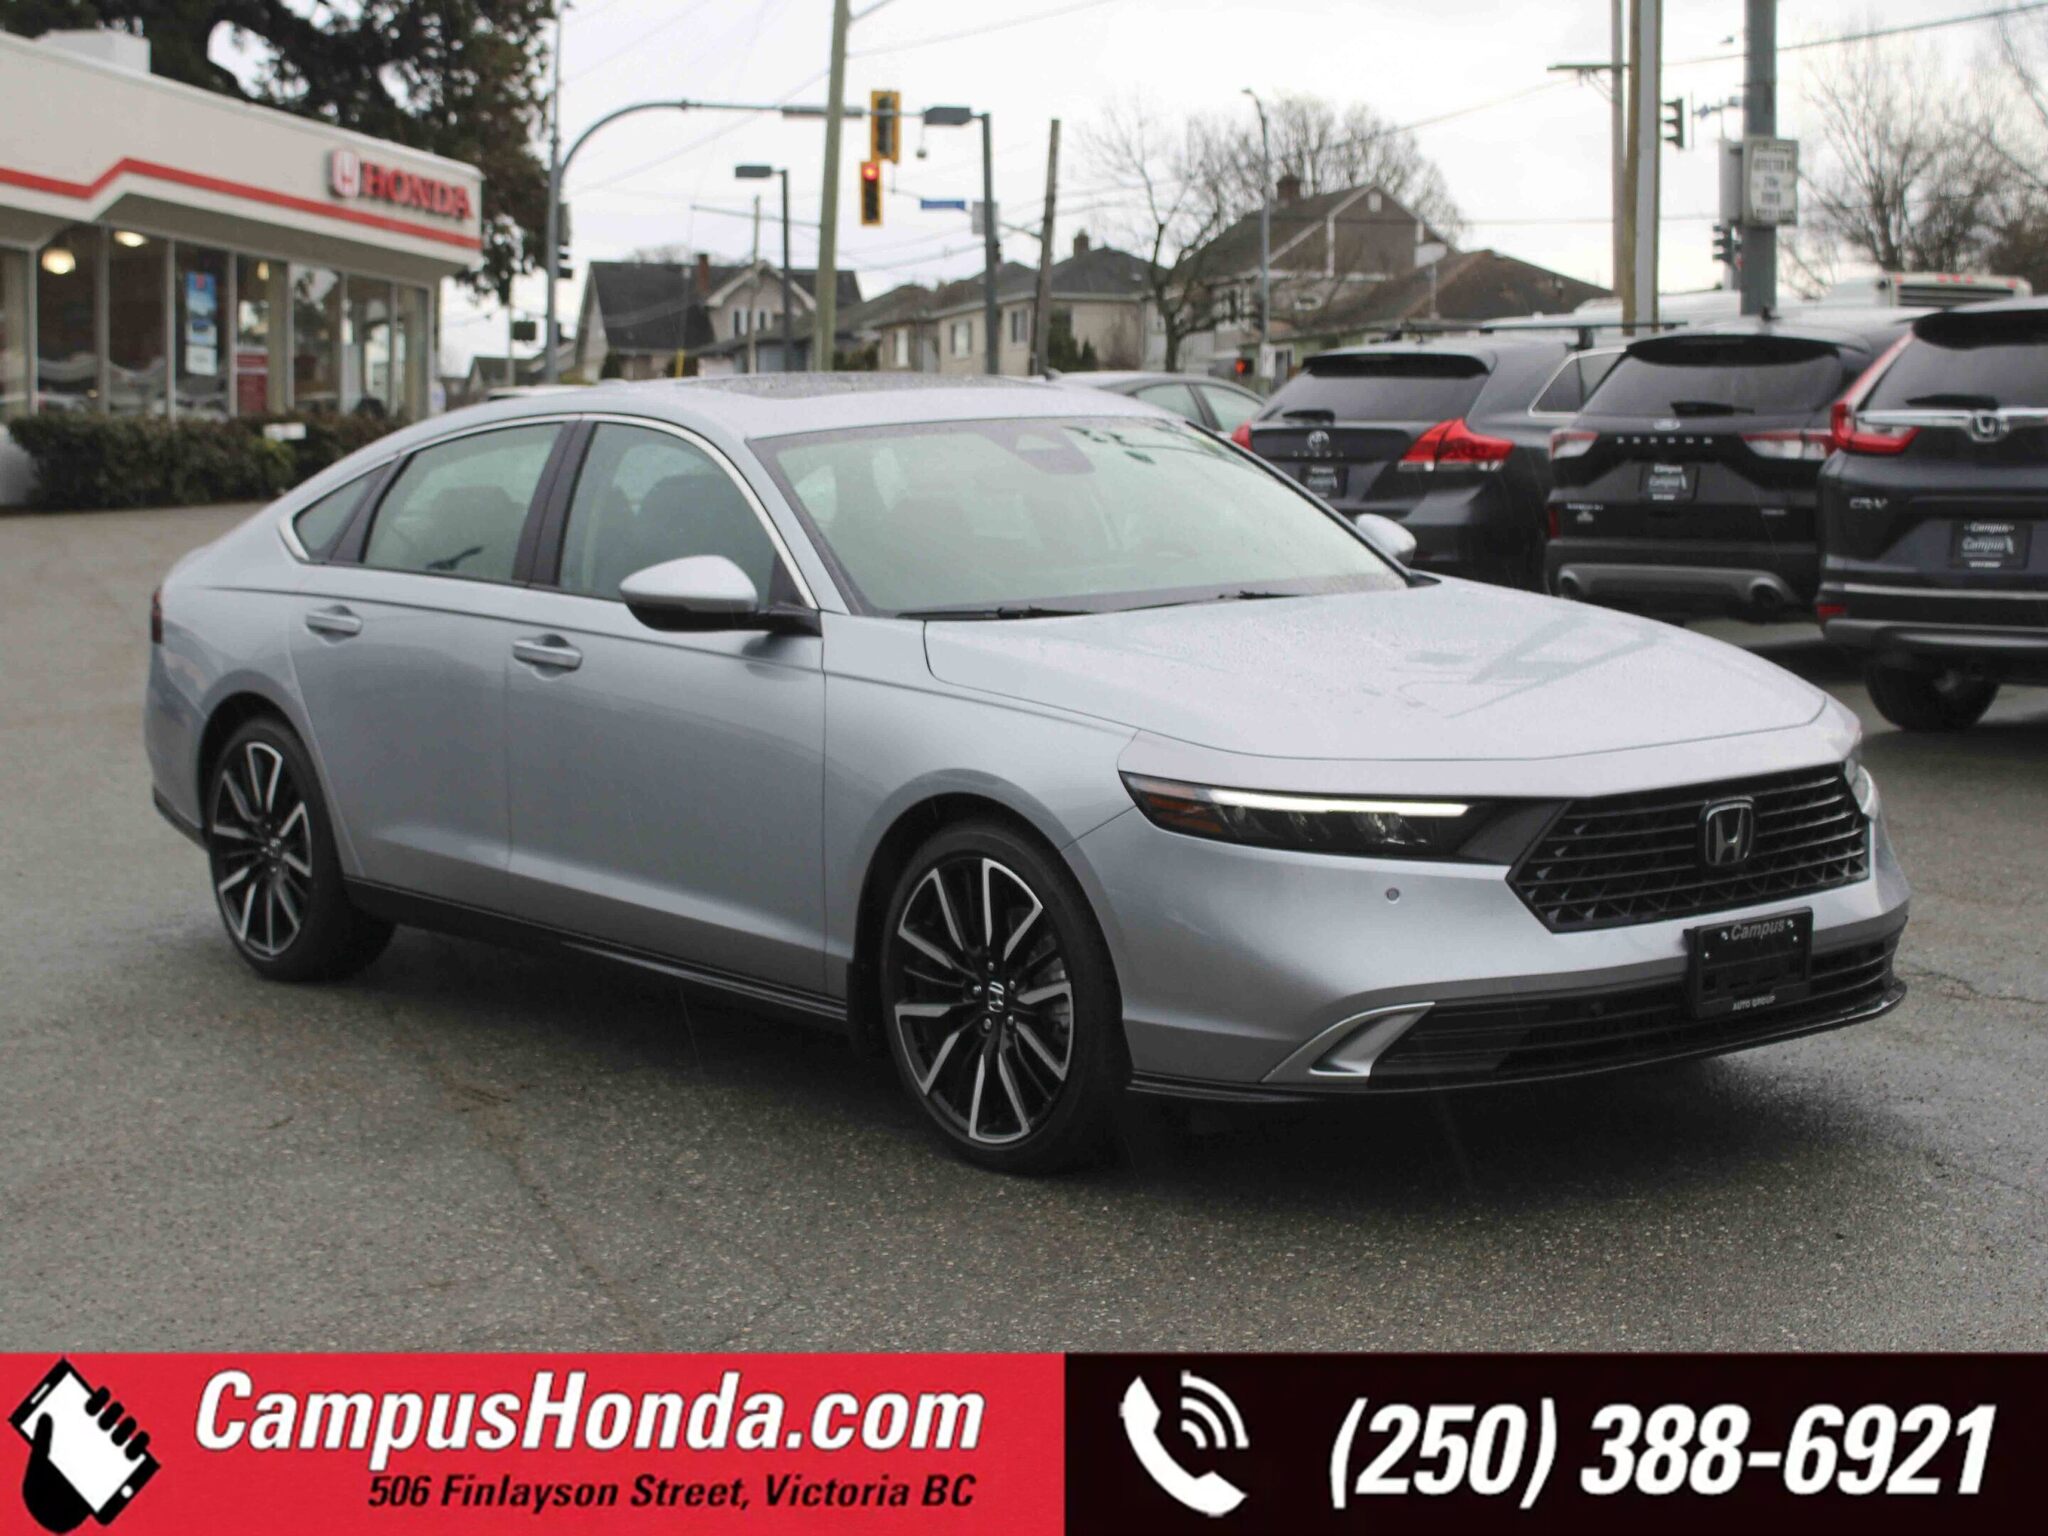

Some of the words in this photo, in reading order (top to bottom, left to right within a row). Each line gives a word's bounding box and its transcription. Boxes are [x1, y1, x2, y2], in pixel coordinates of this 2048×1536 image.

[363, 162, 473, 219] HONDA
[1731, 919, 1785, 941] Campus
[1732, 999, 1751, 1011] AUTO
[1752, 996, 1776, 1007] GROUP
